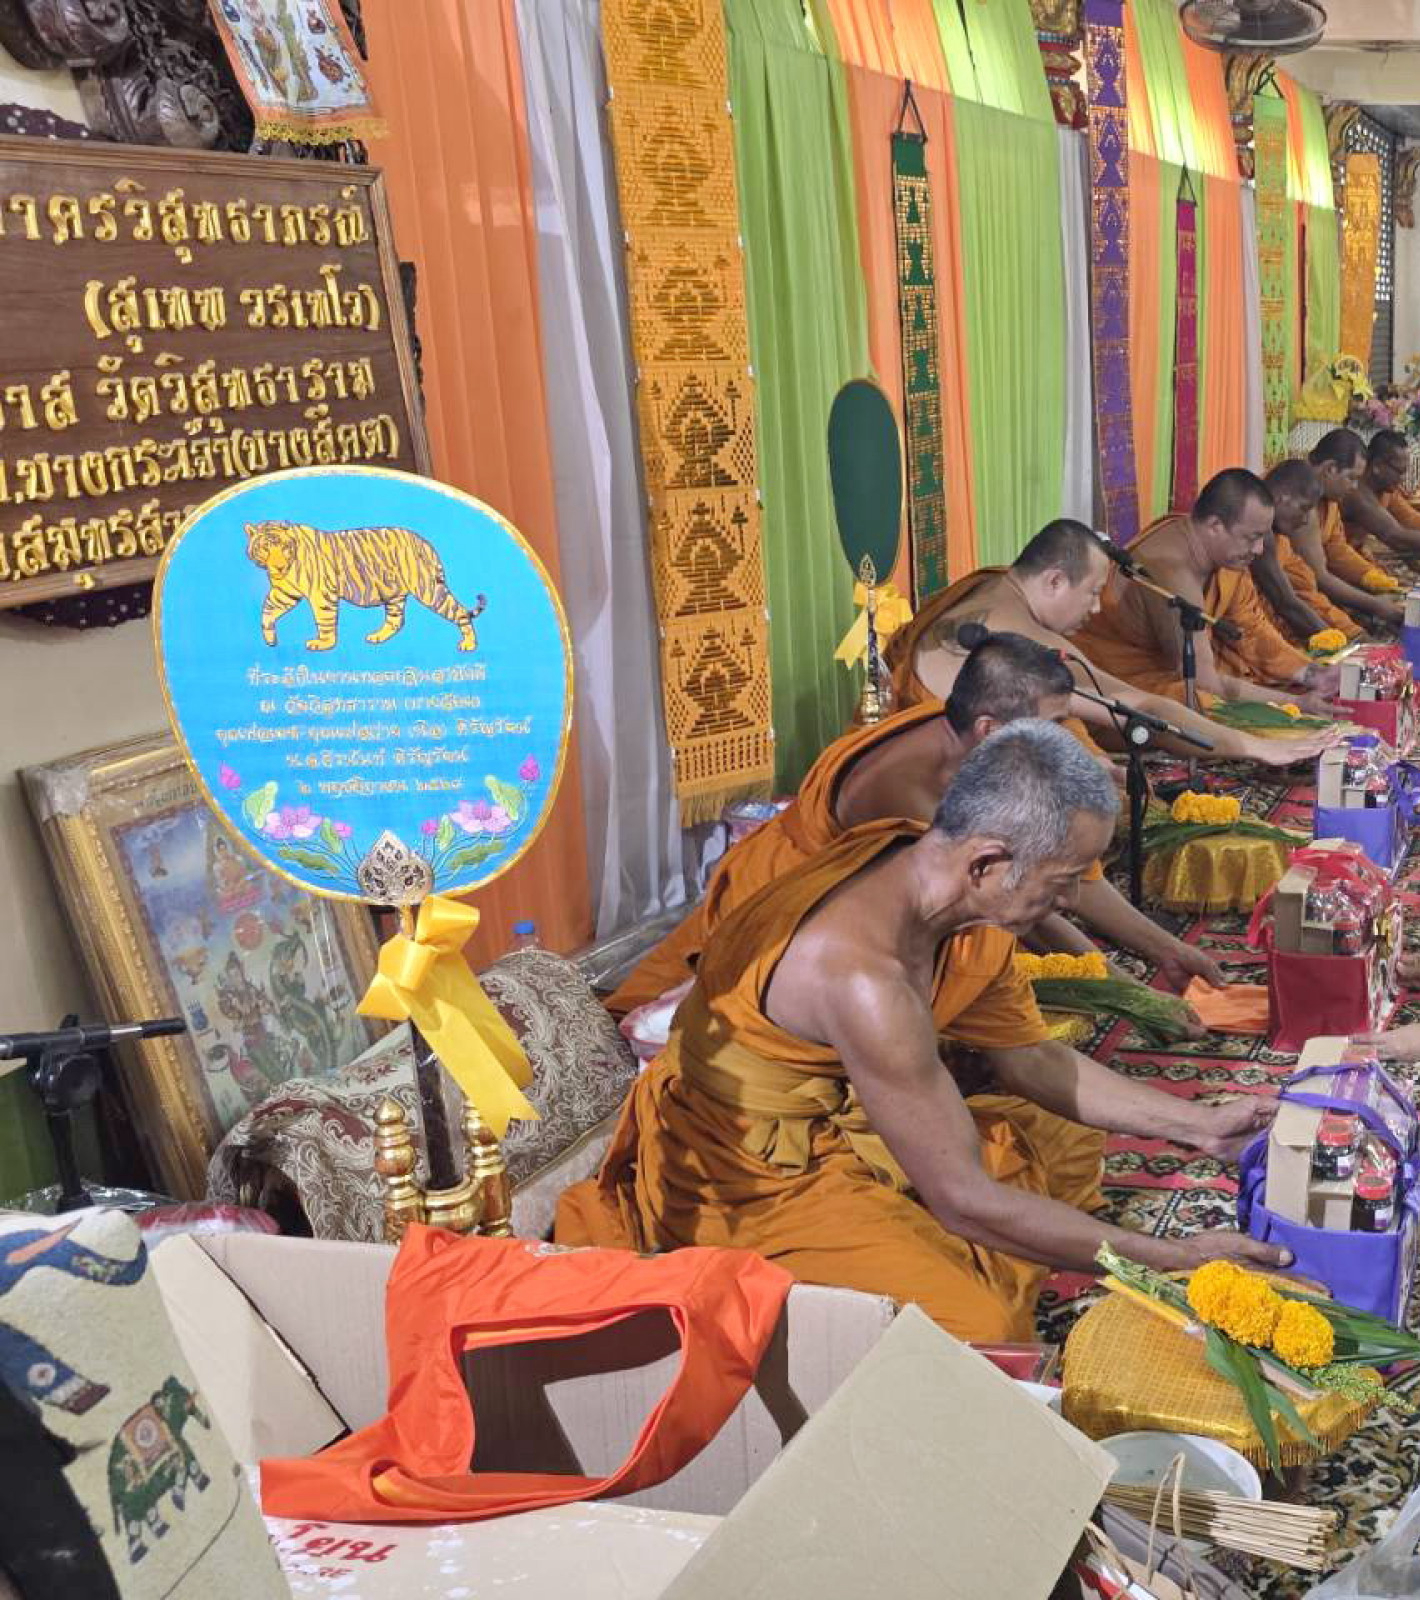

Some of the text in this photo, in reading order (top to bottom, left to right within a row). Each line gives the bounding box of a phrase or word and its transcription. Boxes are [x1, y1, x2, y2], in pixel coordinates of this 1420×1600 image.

[0, 178, 370, 265] าครวิสุทธาภรณ์
[84, 264, 381, 353] (สุเทพ วรเทโว)
[0, 370, 80, 430] าส
[0, 498, 198, 590] .สมุทรสา
